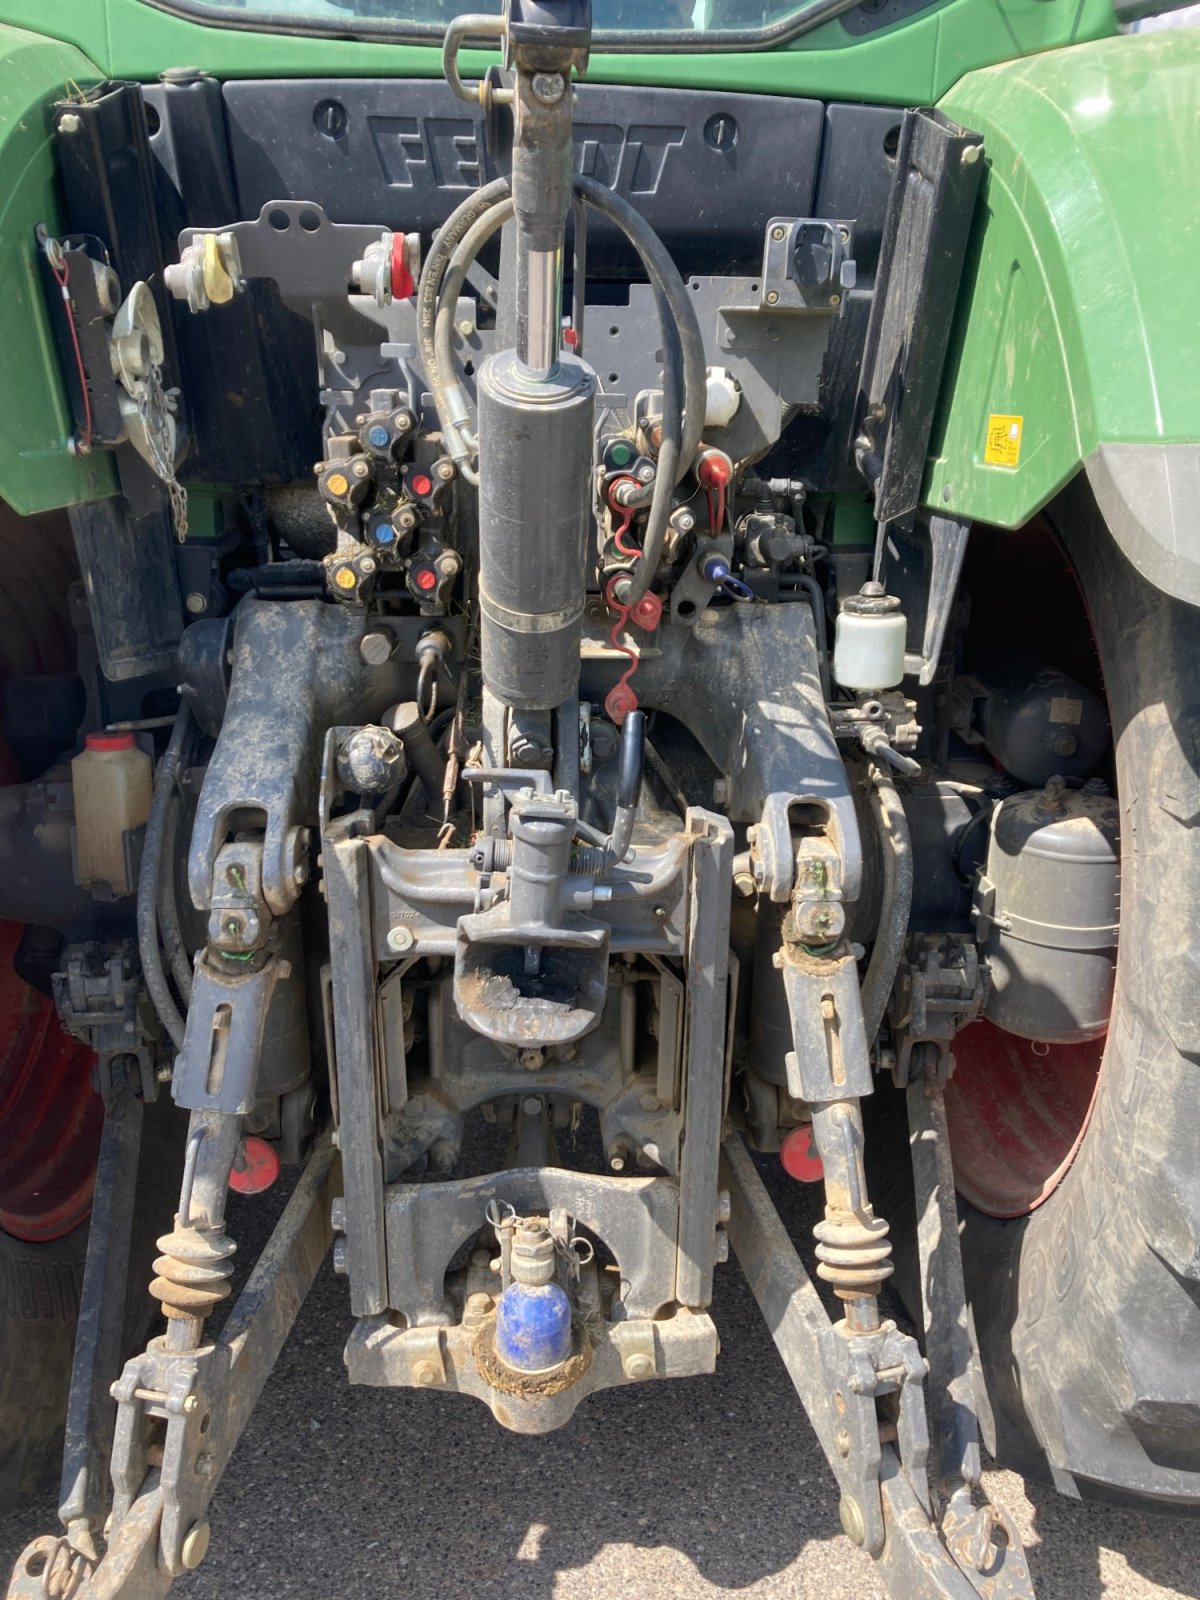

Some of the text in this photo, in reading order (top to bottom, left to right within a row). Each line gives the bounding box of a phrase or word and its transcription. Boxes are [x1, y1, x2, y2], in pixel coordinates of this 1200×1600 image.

[443, 210, 476, 248] GERMANY
[432, 254, 447, 269] DIN
[427, 270, 438, 286] EN
[422, 307, 432, 328] 2SN
